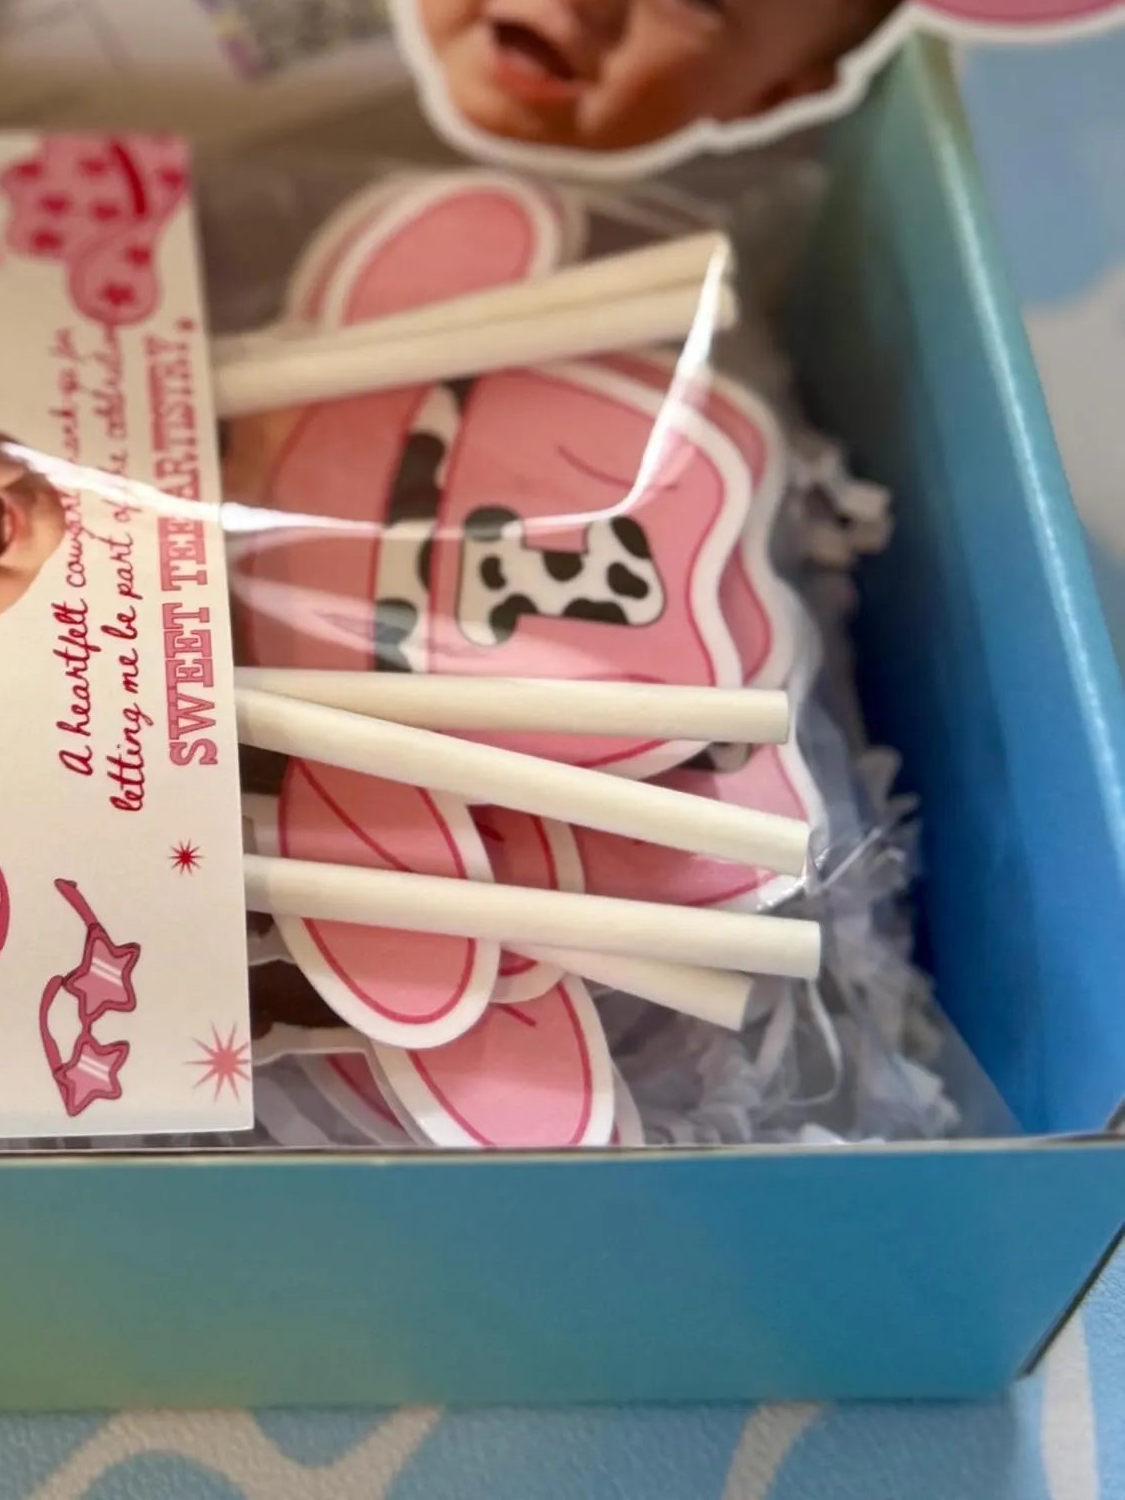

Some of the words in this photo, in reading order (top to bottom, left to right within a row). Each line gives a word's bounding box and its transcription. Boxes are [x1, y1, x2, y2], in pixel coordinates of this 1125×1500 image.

[102, 532, 143, 602] part
[157, 515, 208, 593] TEE
[103, 605, 139, 641] be
[52, 597, 102, 738] heartfelt
[118, 647, 140, 695] me
[163, 602, 219, 766] SWEET
[58, 745, 93, 777] A
[109, 703, 154, 813] letting
